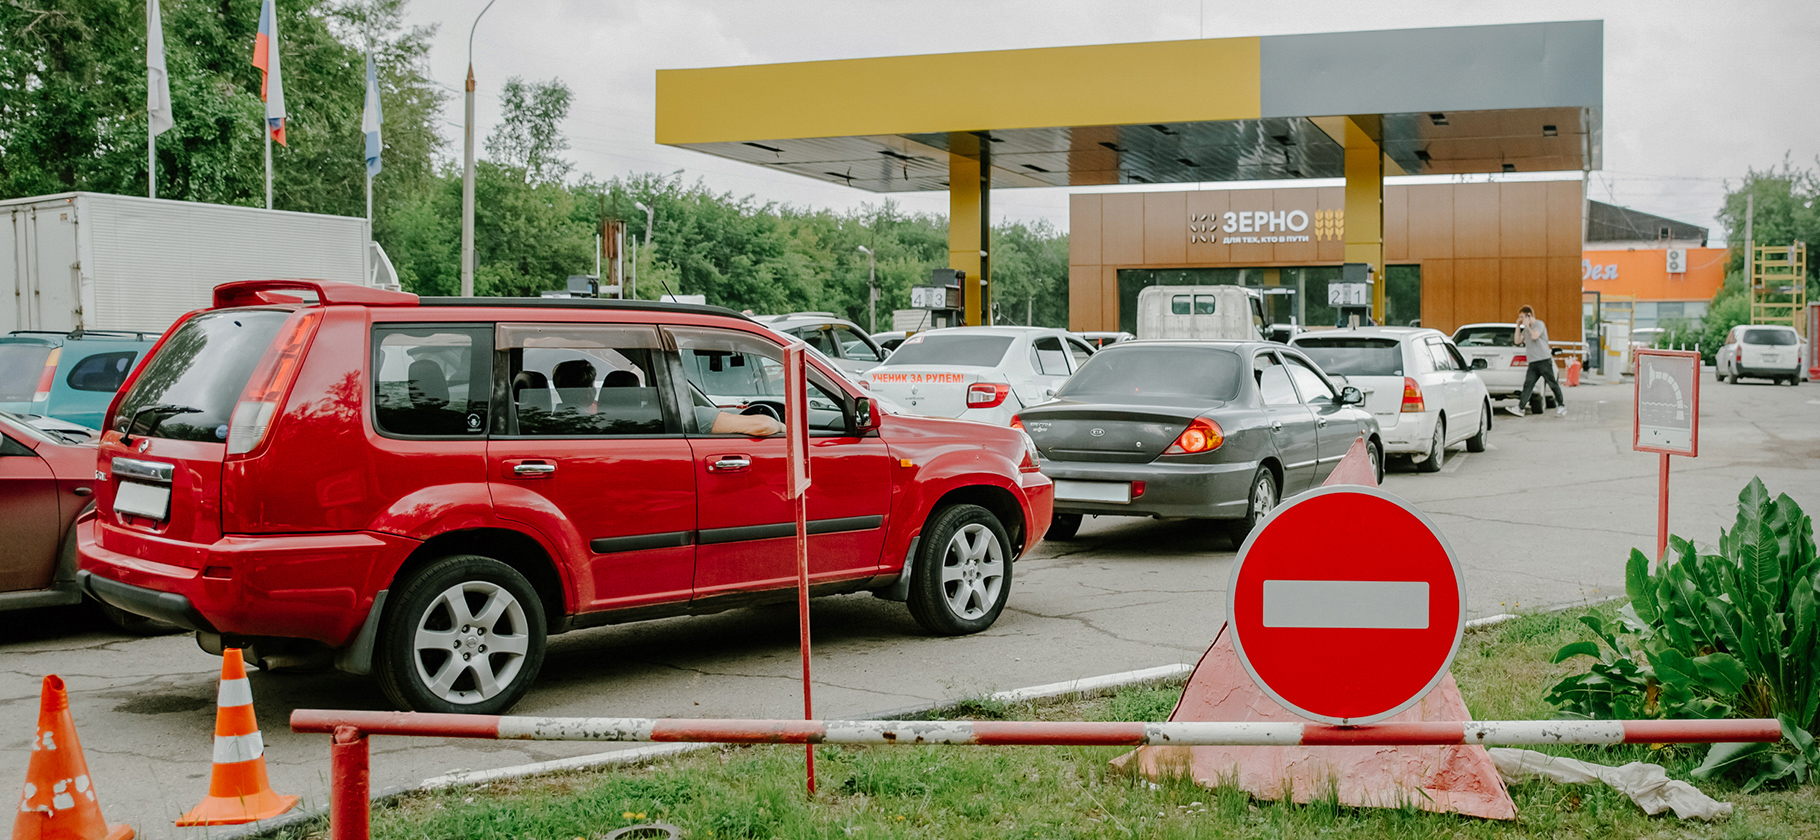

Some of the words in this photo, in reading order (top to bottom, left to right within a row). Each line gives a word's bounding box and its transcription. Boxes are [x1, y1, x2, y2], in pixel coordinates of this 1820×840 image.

[1222, 209, 1309, 233] ЗЕРНО
[1223, 236, 1241, 244] ДЛЯ
[1286, 235, 1309, 243] ПУТИ
[913, 294, 922, 306] 4
[935, 293, 943, 306] 3
[1331, 290, 1340, 304] 2
[1354, 290, 1360, 304] 1
[872, 373, 907, 383] УЧЕНИК
[910, 373, 923, 383] ЗА
[925, 372, 964, 383] РУЛЁМ!
